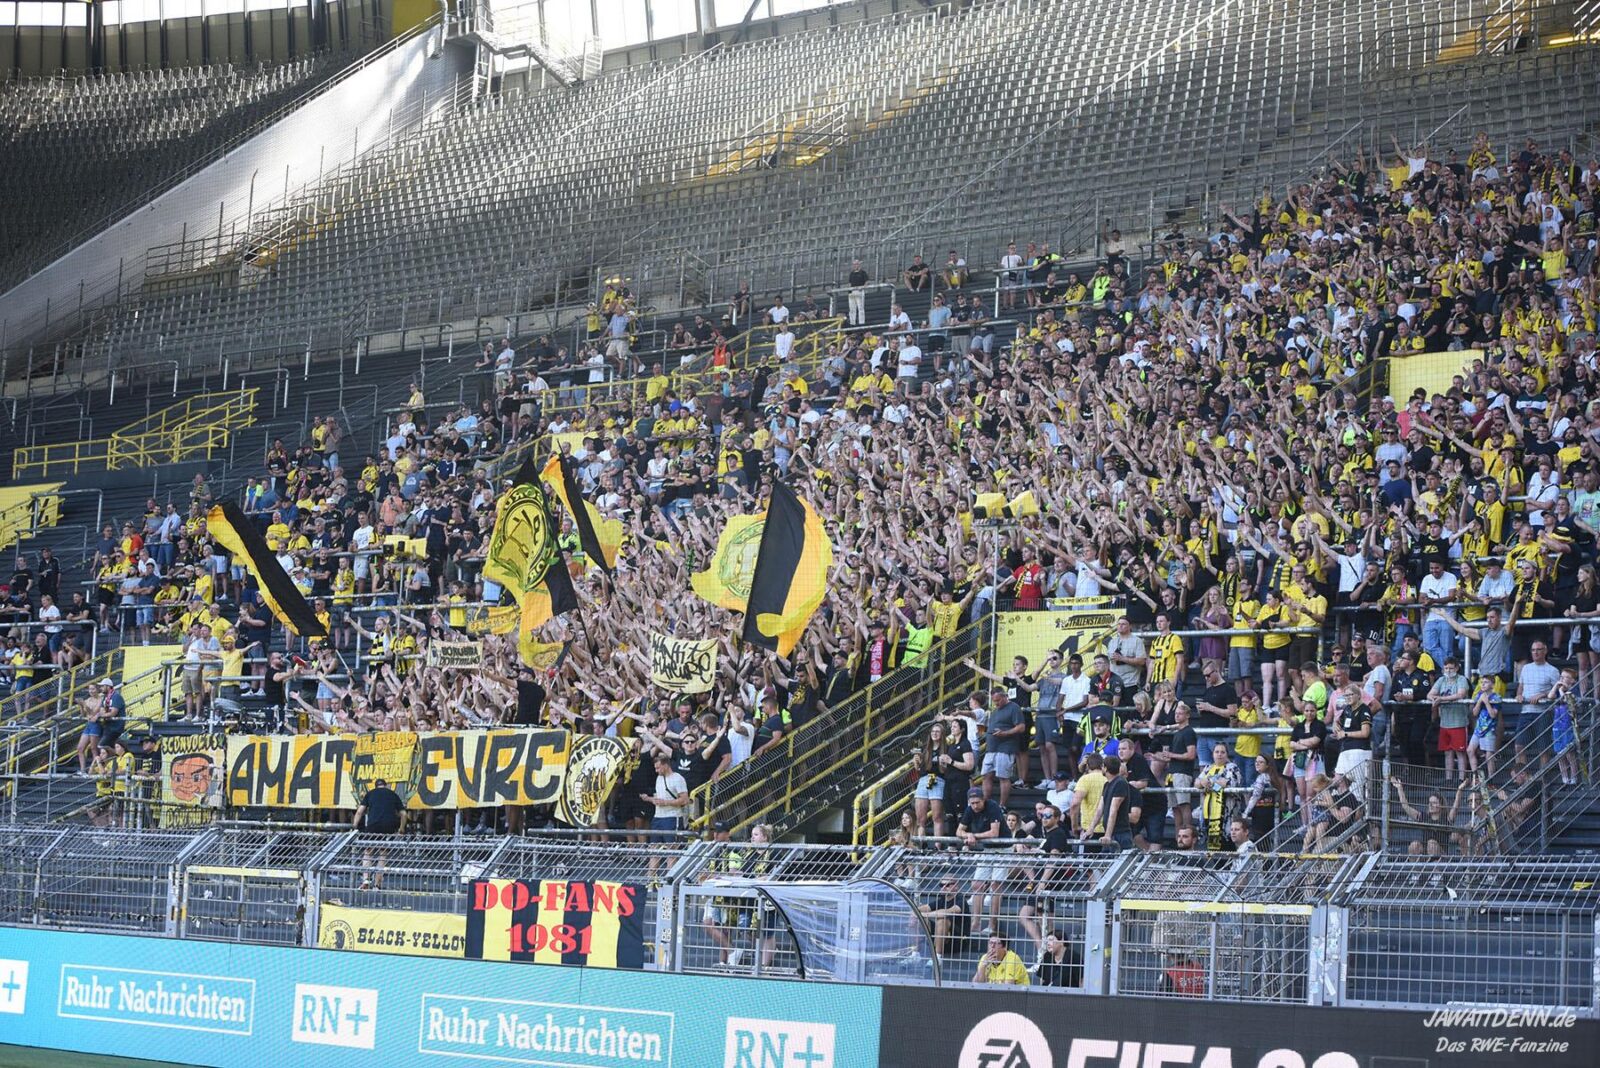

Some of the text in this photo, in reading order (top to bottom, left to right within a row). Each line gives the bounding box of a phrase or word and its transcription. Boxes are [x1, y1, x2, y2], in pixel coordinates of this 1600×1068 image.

[473, 881, 636, 917] DO-FANS
[505, 923, 592, 955] 1981
[64, 976, 113, 1008] Ruhr
[118, 980, 246, 1023] Nachrichten
[427, 1006, 662, 1061] Ruhr Nachrichten
